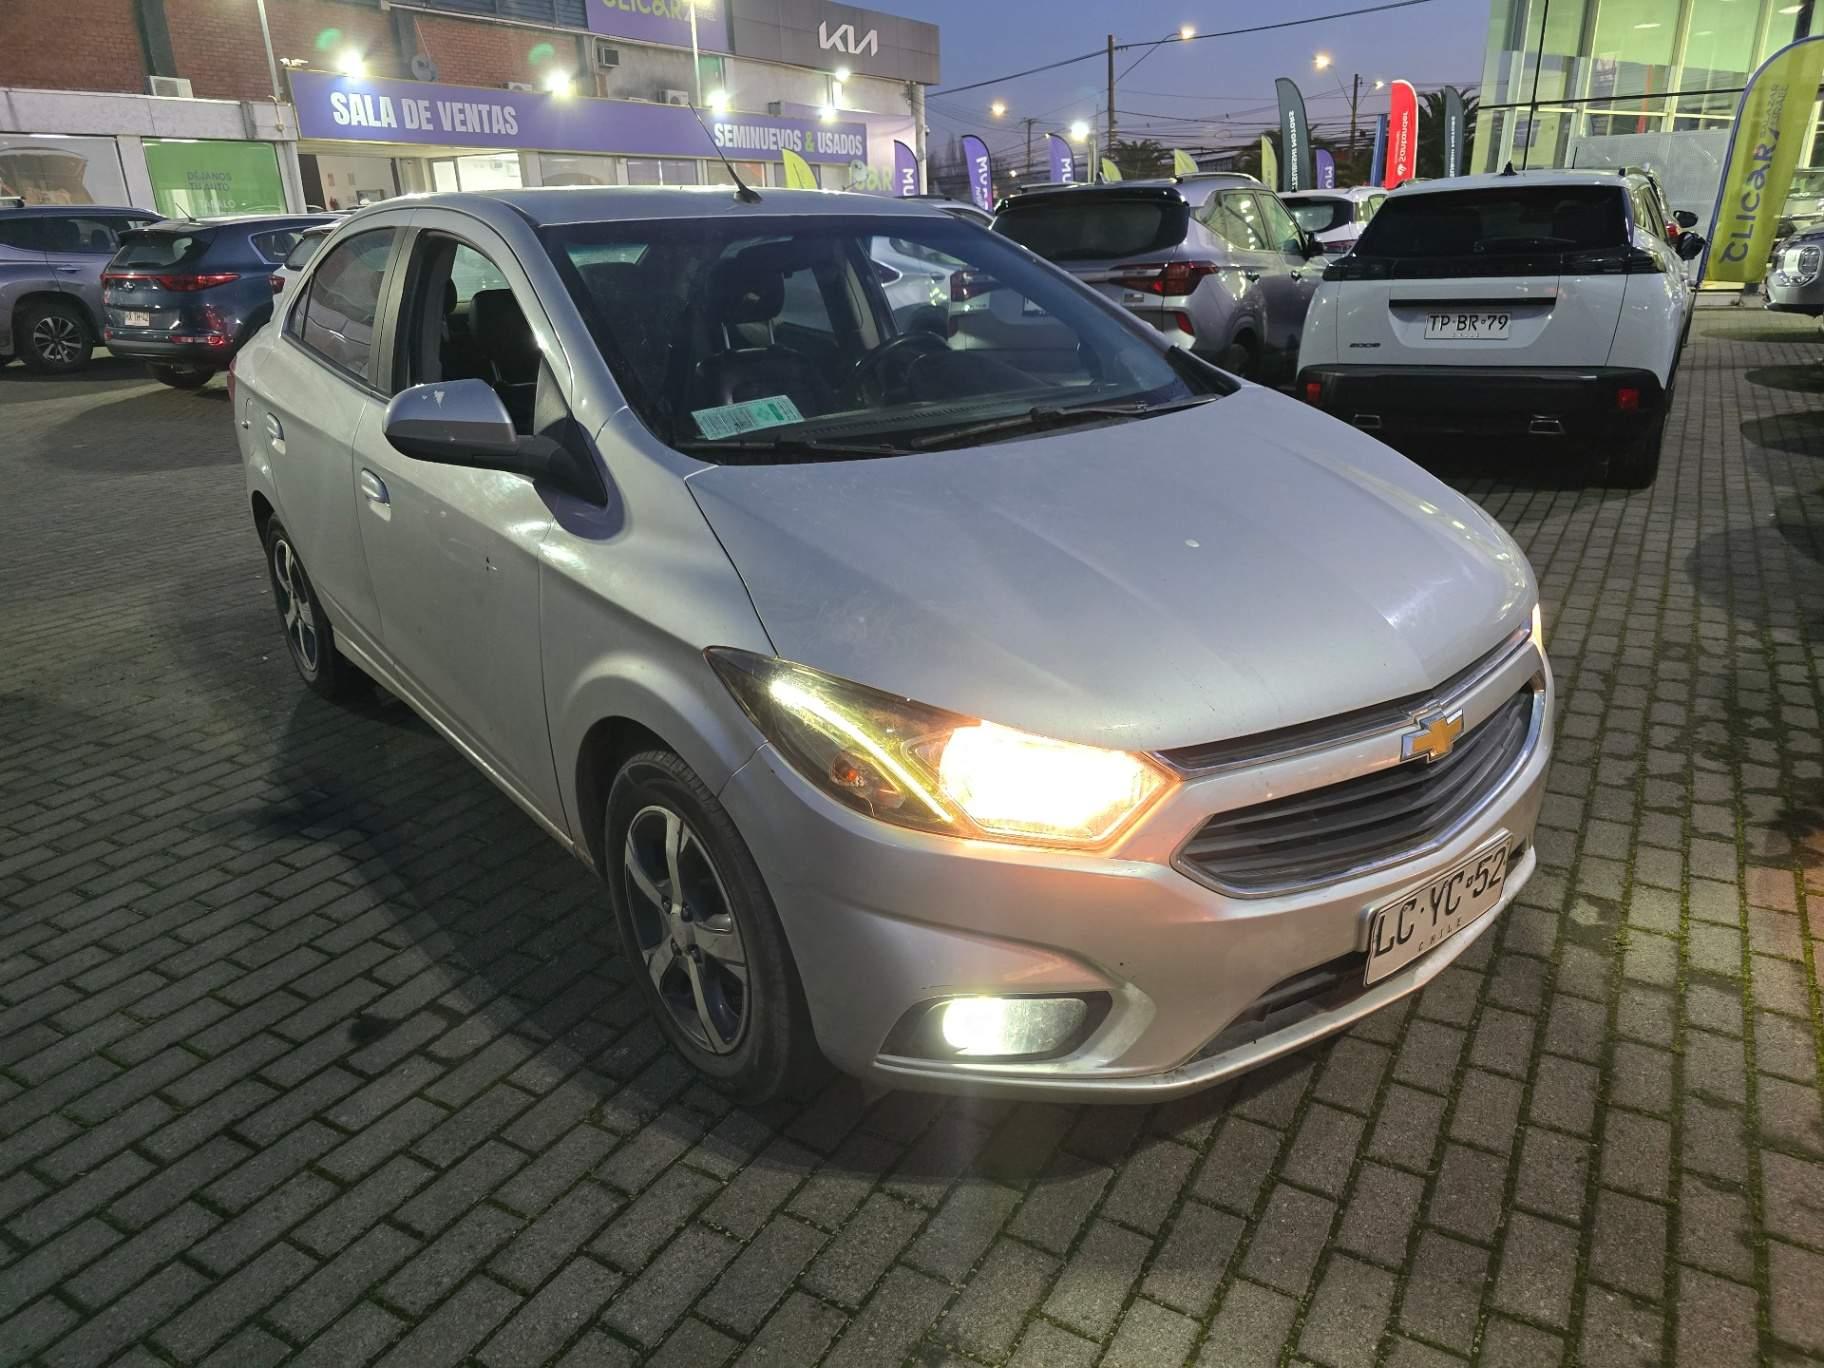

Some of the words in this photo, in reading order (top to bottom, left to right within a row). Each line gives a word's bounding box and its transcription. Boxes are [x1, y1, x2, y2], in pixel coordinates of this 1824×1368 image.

[819, 20, 878, 57] KIA
[330, 92, 398, 128] SALA
[401, 98, 434, 131] DE
[437, 101, 519, 135] VENTAS
[714, 123, 802, 152] SEMINUEVOS
[805, 131, 815, 152] &
[817, 132, 863, 155] USADOS
